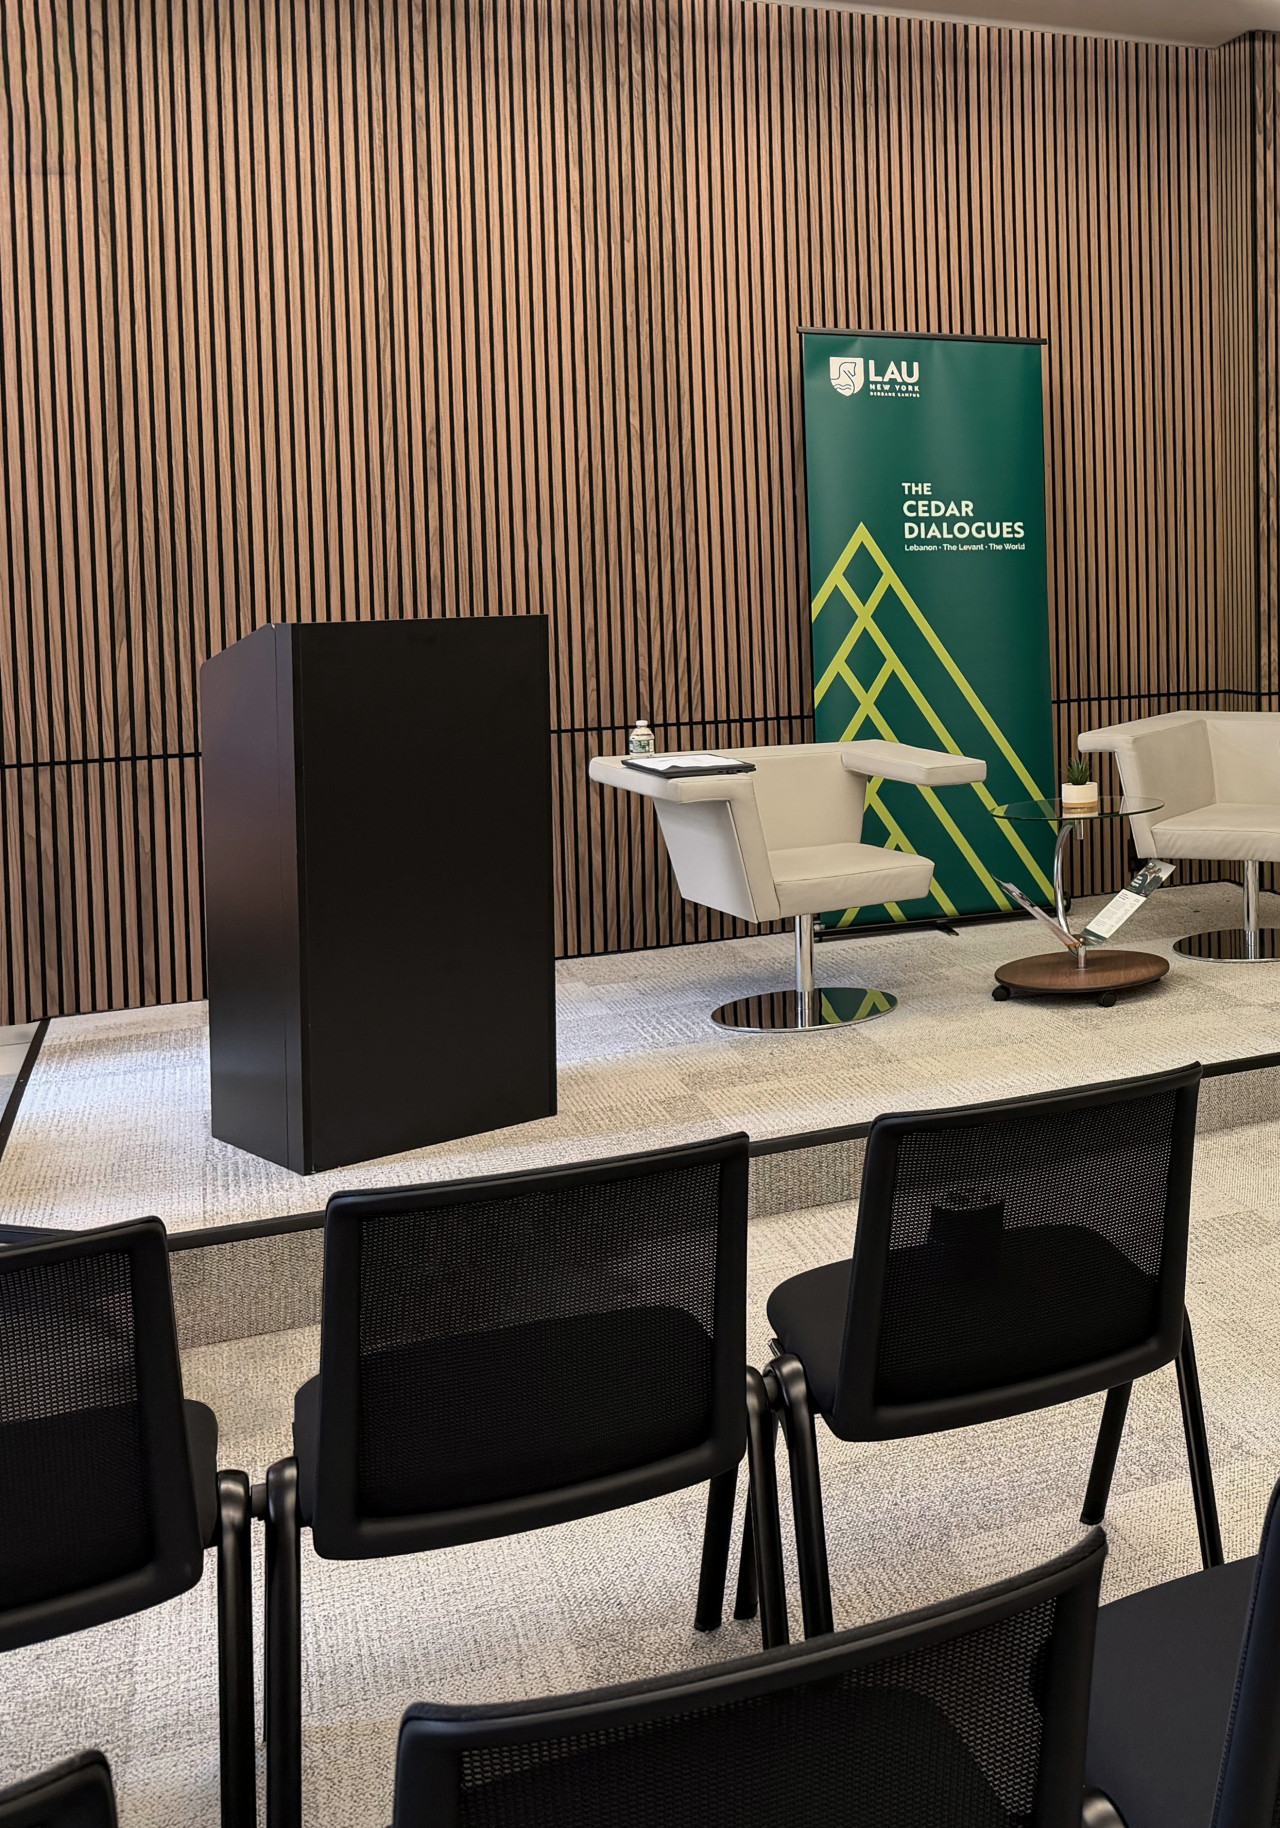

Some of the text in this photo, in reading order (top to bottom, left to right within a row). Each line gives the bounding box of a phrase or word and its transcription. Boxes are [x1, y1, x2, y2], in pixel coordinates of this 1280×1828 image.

[868, 359, 920, 384] LAU
[869, 383, 920, 392] NEW YORK
[901, 482, 932, 495] THE
[902, 500, 974, 517] CEDAR
[904, 521, 1025, 539] DIALOGUES
[904, 542, 1026, 552] Lebanon The Levant The World
